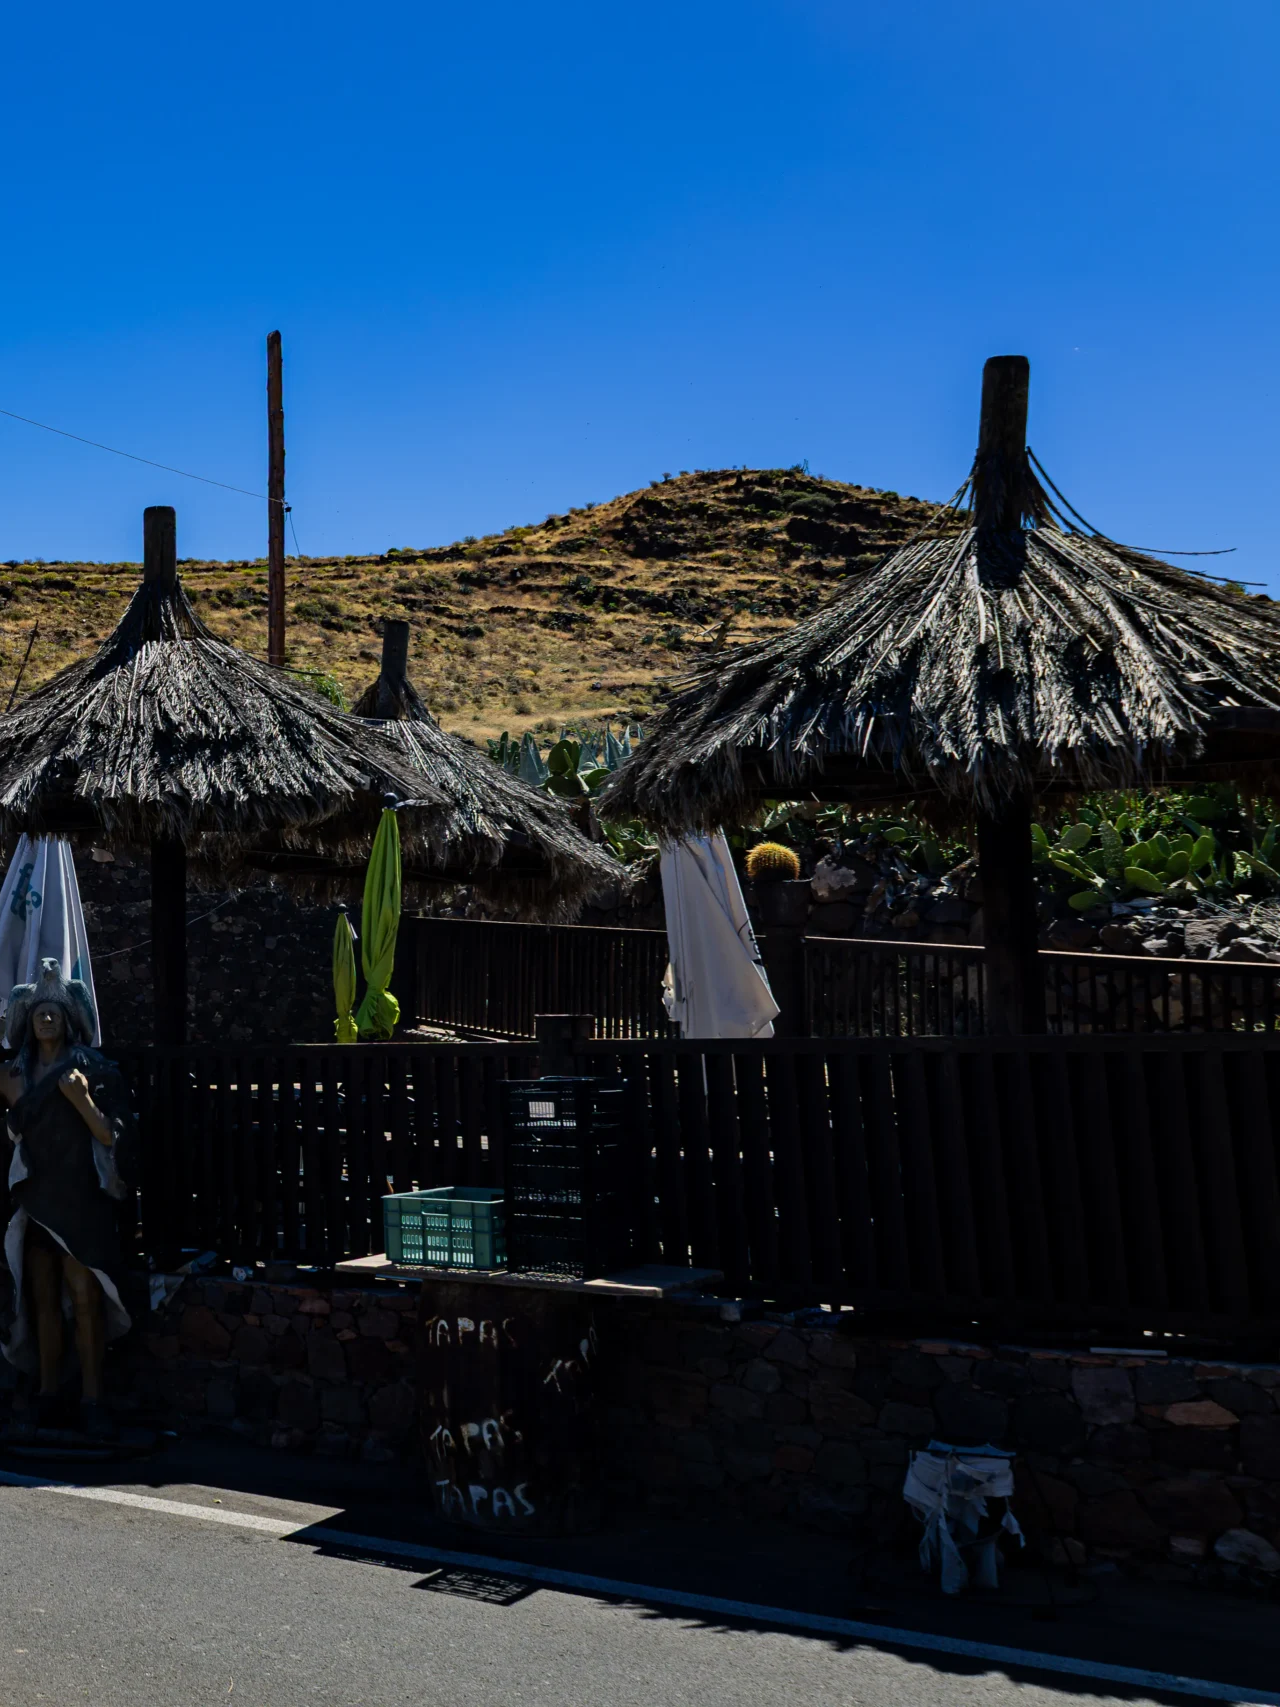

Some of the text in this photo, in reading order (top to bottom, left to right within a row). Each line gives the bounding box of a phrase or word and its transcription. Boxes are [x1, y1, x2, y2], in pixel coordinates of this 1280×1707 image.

[424, 1314, 519, 1350] TAPAS
[429, 1408, 524, 1462] TAPAS
[435, 1479, 536, 1517] TAPAS
